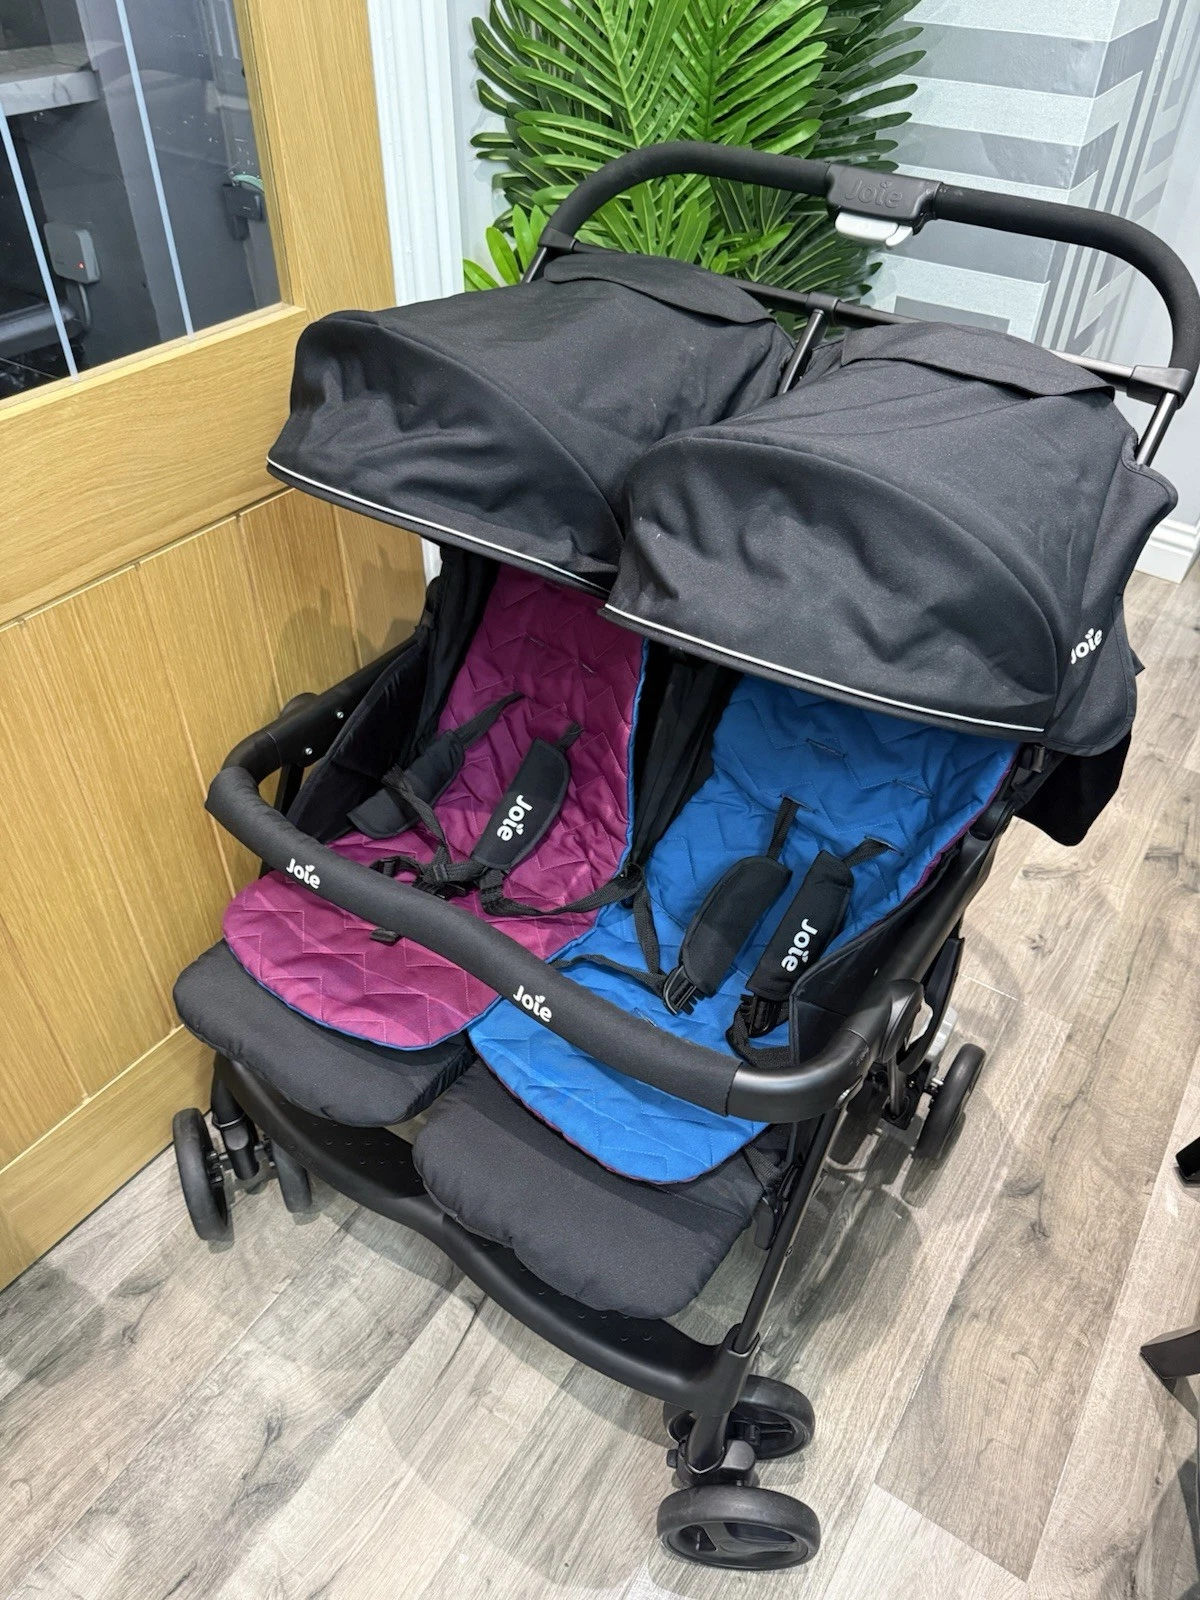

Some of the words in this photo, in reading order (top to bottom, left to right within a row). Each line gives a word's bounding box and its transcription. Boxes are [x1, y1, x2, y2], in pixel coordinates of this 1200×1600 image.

[844, 180, 903, 208] Joie
[1070, 628, 1103, 665] Joie
[496, 794, 533, 841] Joie
[286, 857, 321, 889] Joie
[781, 918, 818, 972] Joie
[512, 985, 553, 1022] Joie
